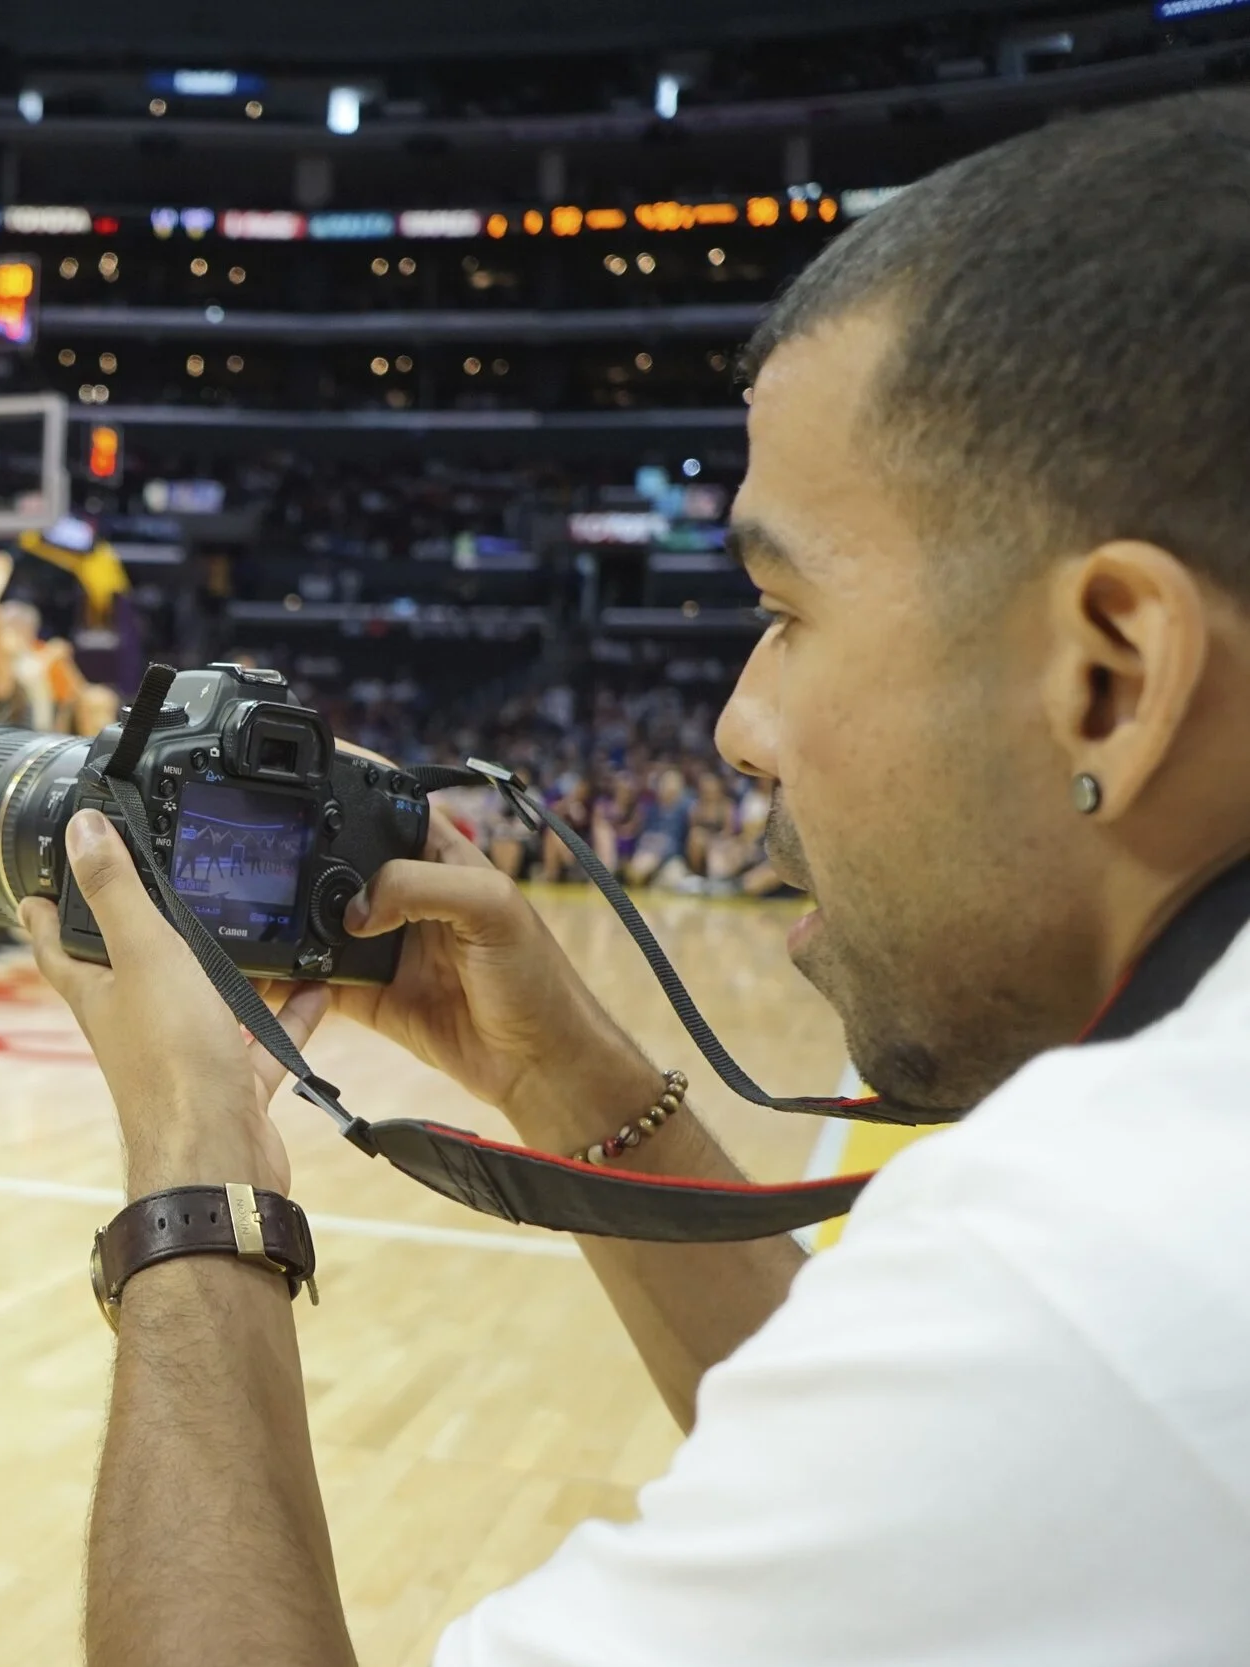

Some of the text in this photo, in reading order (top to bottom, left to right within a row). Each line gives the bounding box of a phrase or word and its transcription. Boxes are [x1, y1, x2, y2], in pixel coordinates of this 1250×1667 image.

[163, 765, 183, 775] MENU
[218, 925, 248, 938] Canon
[236, 1198, 251, 1235] NIXON
